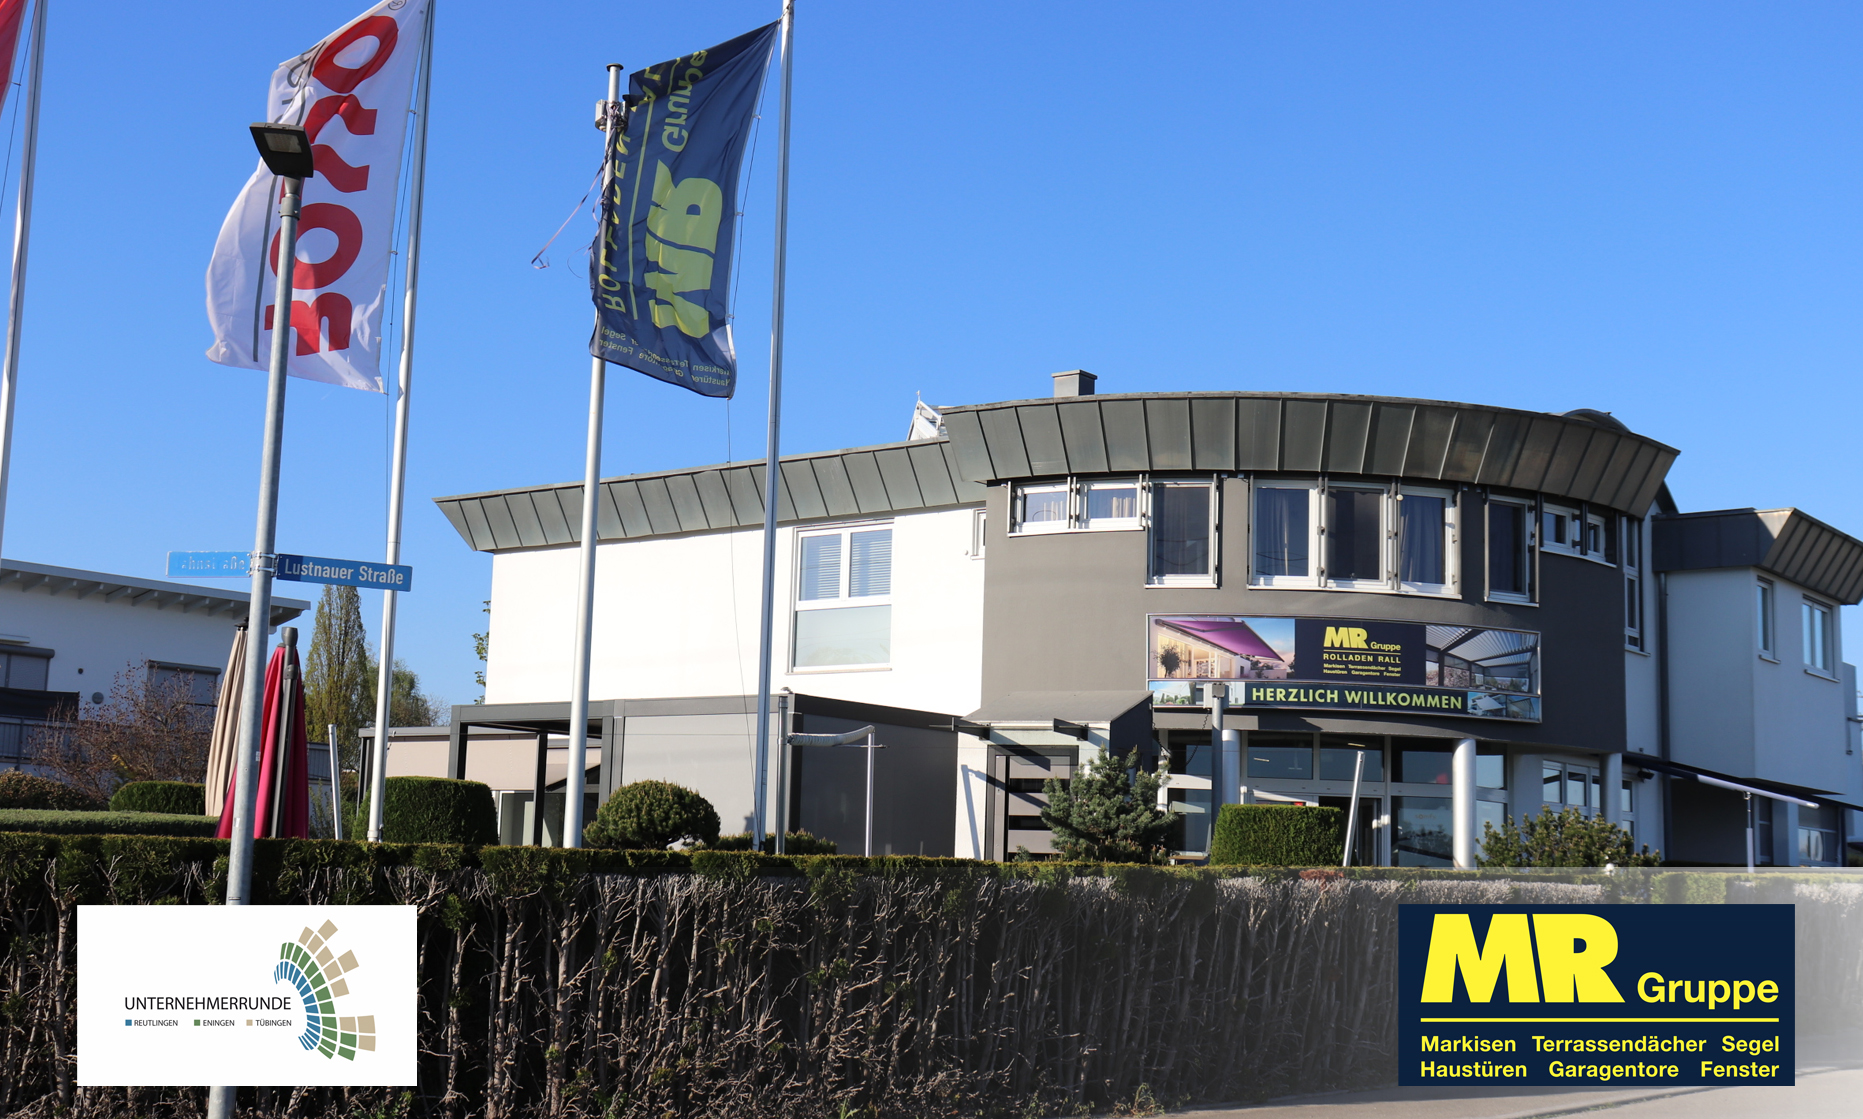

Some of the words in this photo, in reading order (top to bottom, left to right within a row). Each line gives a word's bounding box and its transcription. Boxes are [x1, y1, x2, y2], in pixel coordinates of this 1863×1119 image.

[178, 556, 246, 570] ahnstaße
[284, 558, 354, 580] Lustnauer
[358, 566, 404, 585] Straße
[1323, 626, 1369, 649] MR
[1370, 641, 1401, 651] Gruppe
[1323, 653, 1373, 662] ROLLADEN
[1378, 655, 1401, 664] RALL
[1251, 686, 1339, 704] HERZLICH
[1345, 690, 1463, 710] WILLKOMMEN
